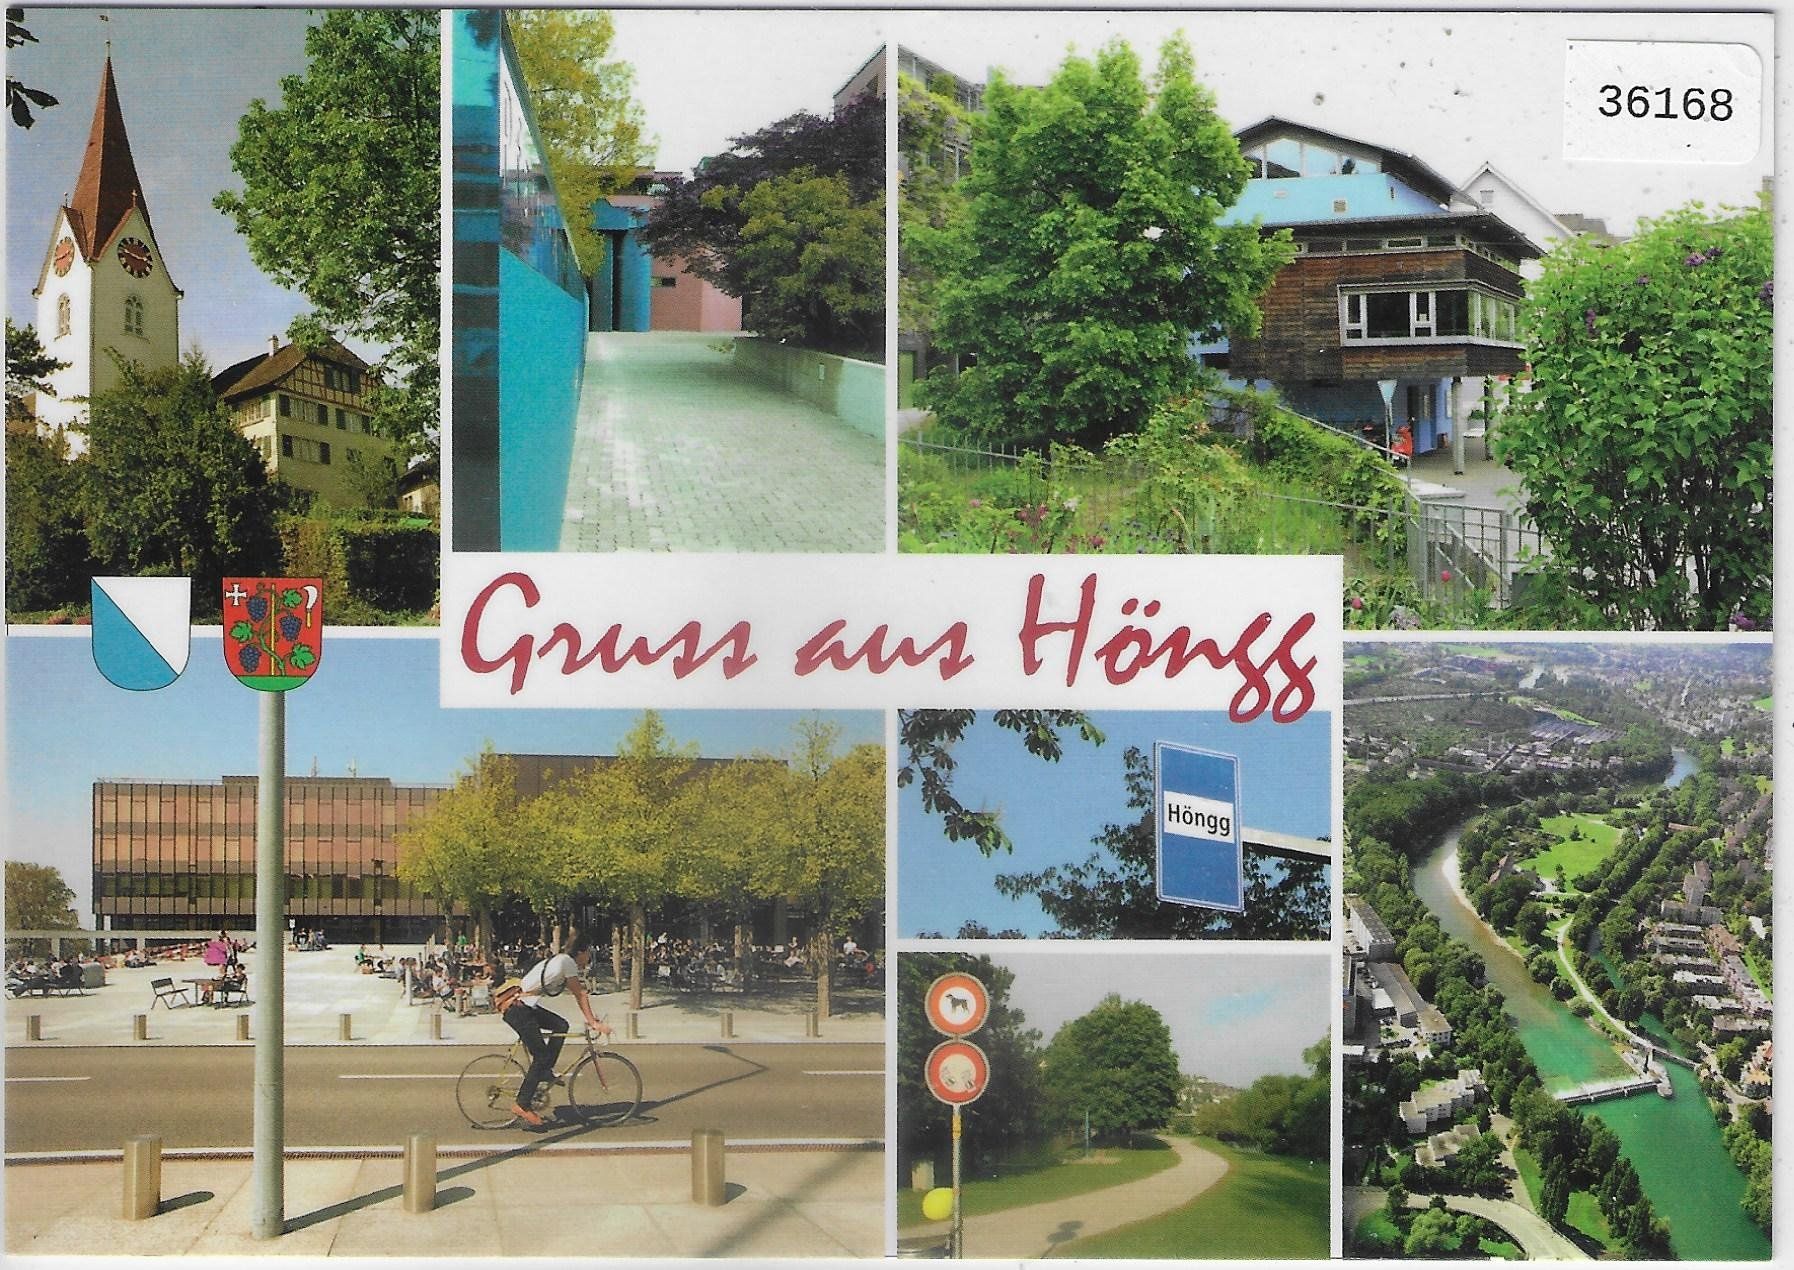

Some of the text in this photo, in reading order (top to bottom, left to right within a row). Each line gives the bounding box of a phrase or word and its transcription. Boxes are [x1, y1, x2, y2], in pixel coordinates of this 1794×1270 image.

[1598, 84, 1733, 121] 36168
[461, 571, 1317, 723] Gruss aus Höngg
[1168, 803, 1230, 837] Höngg
